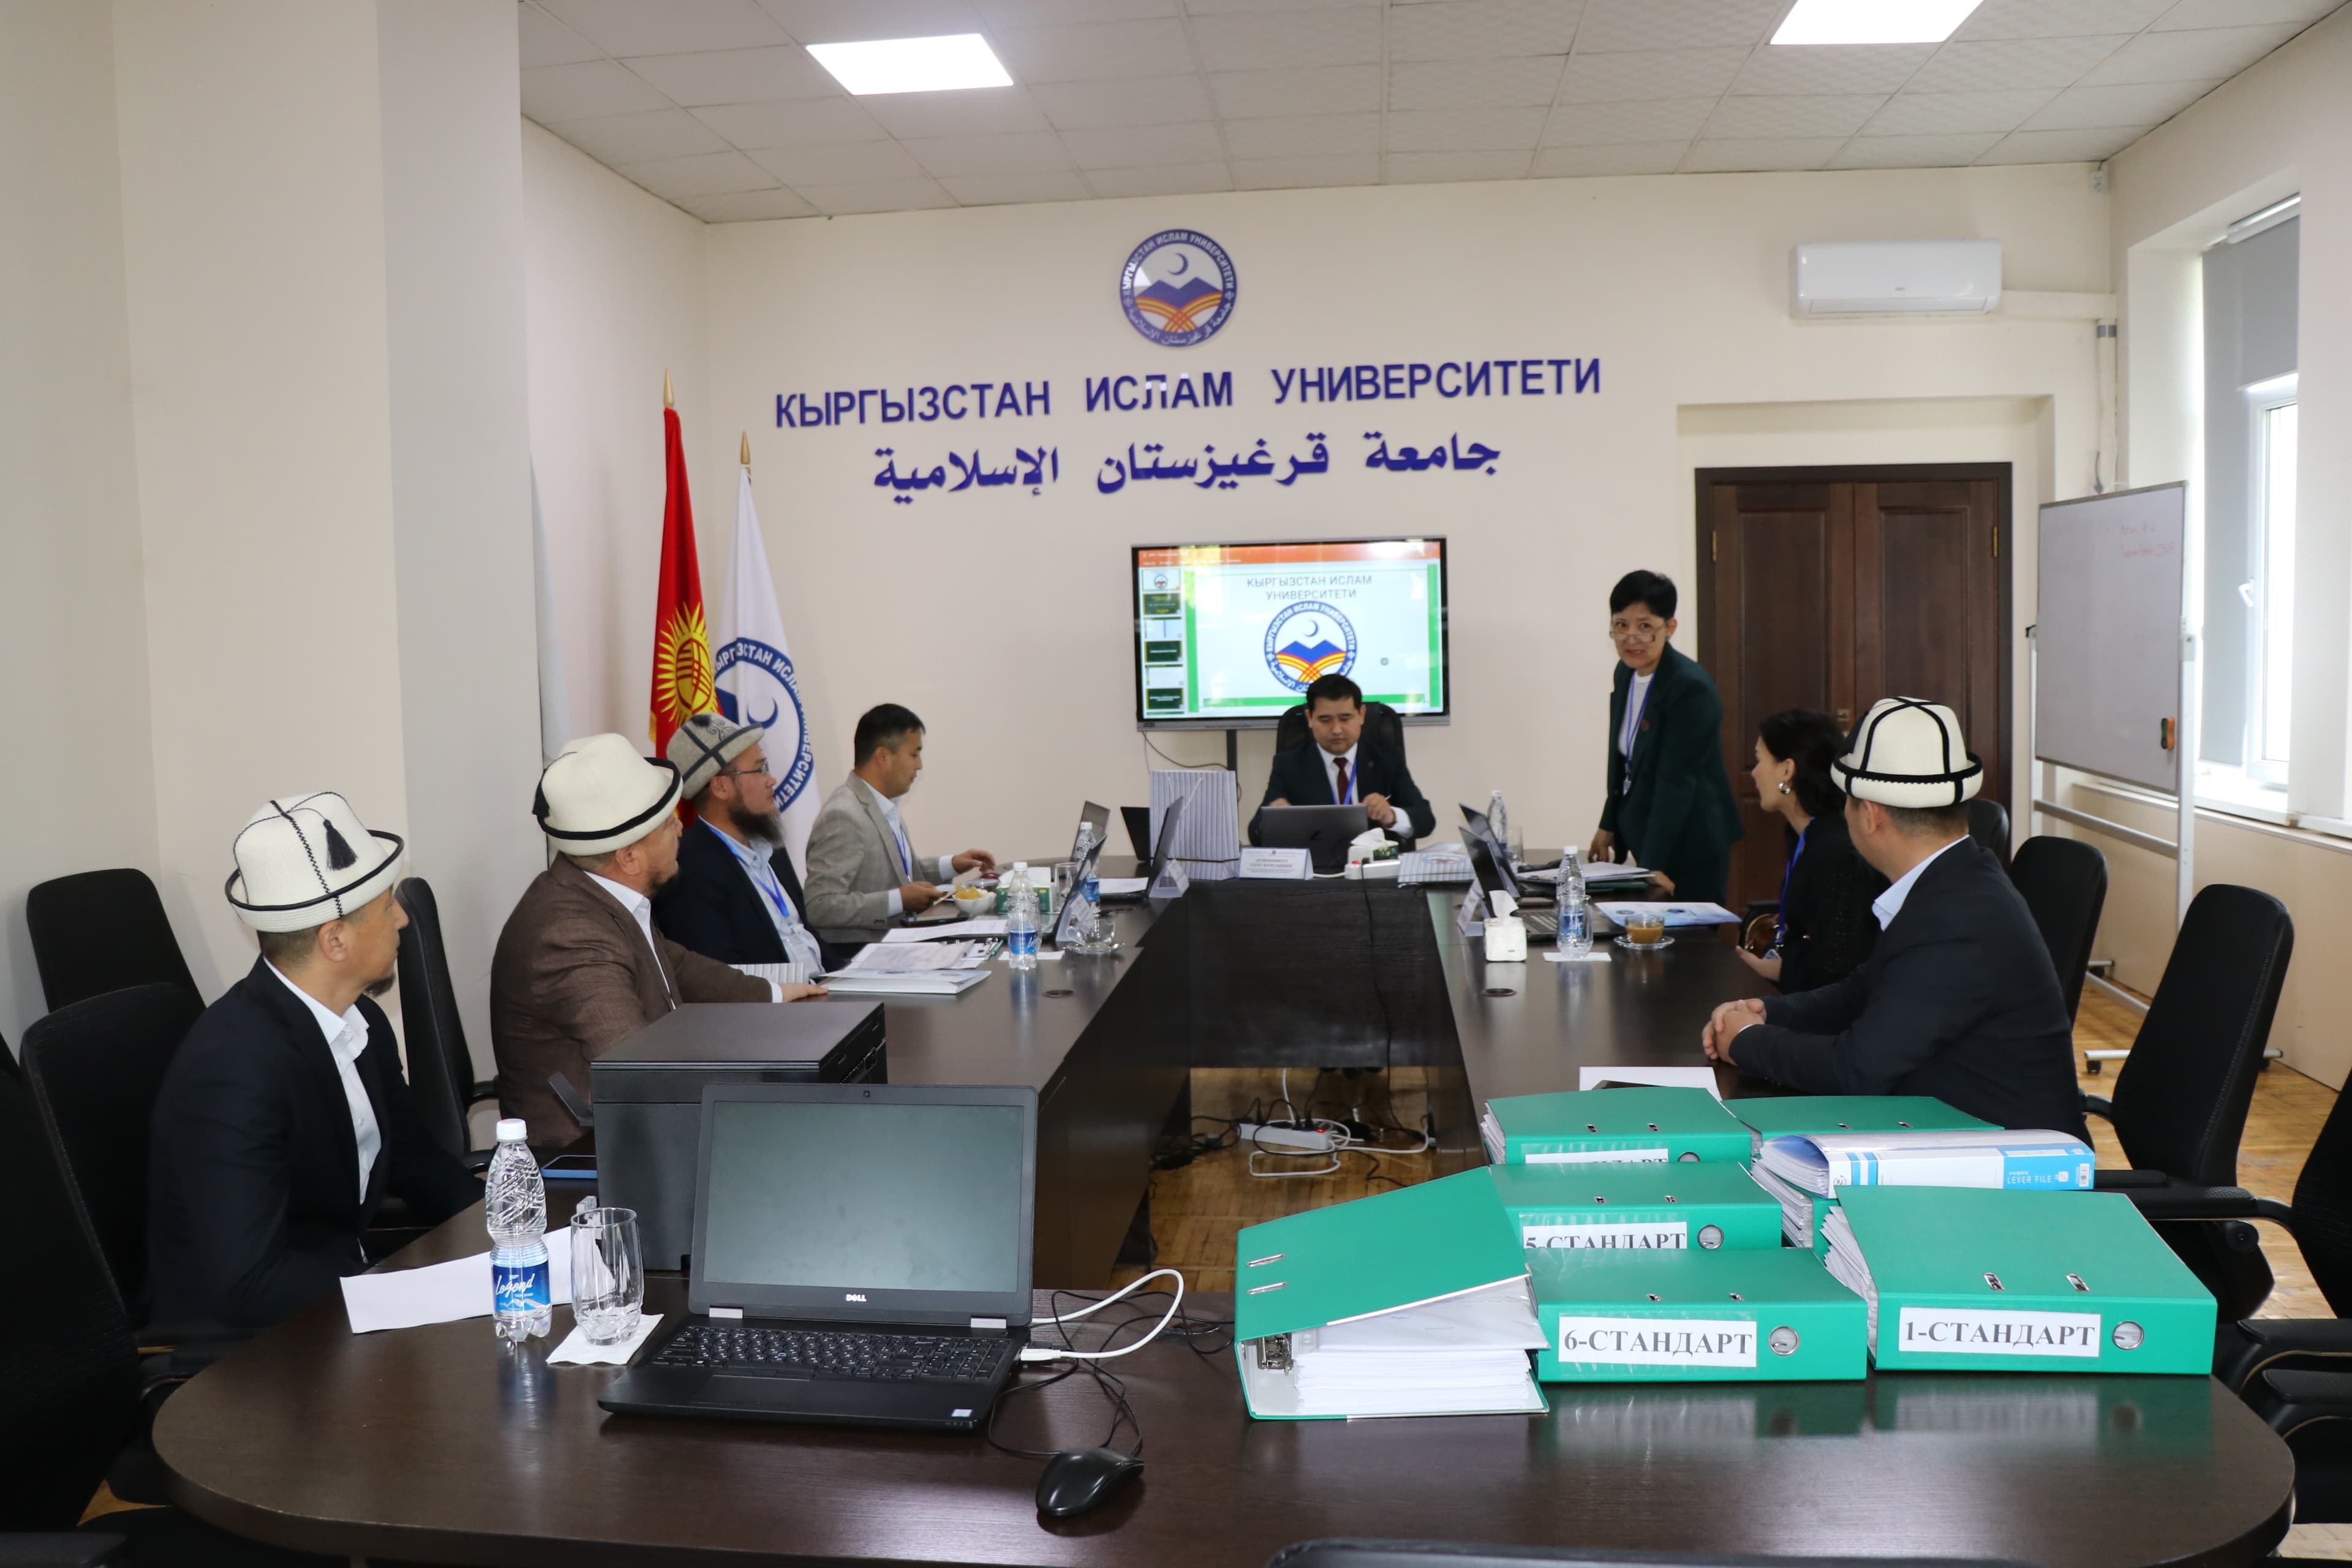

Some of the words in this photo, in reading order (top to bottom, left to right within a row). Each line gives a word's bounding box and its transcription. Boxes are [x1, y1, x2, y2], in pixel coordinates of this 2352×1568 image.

[1122, 239, 1156, 295] КЫРГЫЗСТАН
[1156, 232, 1188, 246] ИСЛАМ
[1189, 233, 1235, 289] УНИВЕРСИТЕТИ
[776, 380, 1051, 428] КЫРГЫЗСТАН
[1085, 371, 1234, 412] ИСЛАМ
[1270, 358, 1600, 404] УНИВЕРСИТЕТИ
[1097, 431, 1330, 494] قرغيزستان
[1363, 431, 1501, 476] جامعة
[874, 445, 1060, 505] الإسلامية
[1246, 576, 1326, 588] КЫРГЫЗСТАН
[1330, 575, 1373, 586] ИСЛАМ
[1266, 589, 1357, 600] УНИВЕРСИТЕТИ
[1293, 602, 1320, 612] ИСЛАМ
[1321, 604, 1356, 650] УНИВЕРСИТЕТИ
[2007, 1175, 2032, 1184] LEVER
[496, 1273, 535, 1298] Legend
[1564, 1329, 1752, 1357] 6-СТАНДАРТ
[1905, 1321, 2095, 1349] 1-СТАНДАРТ
